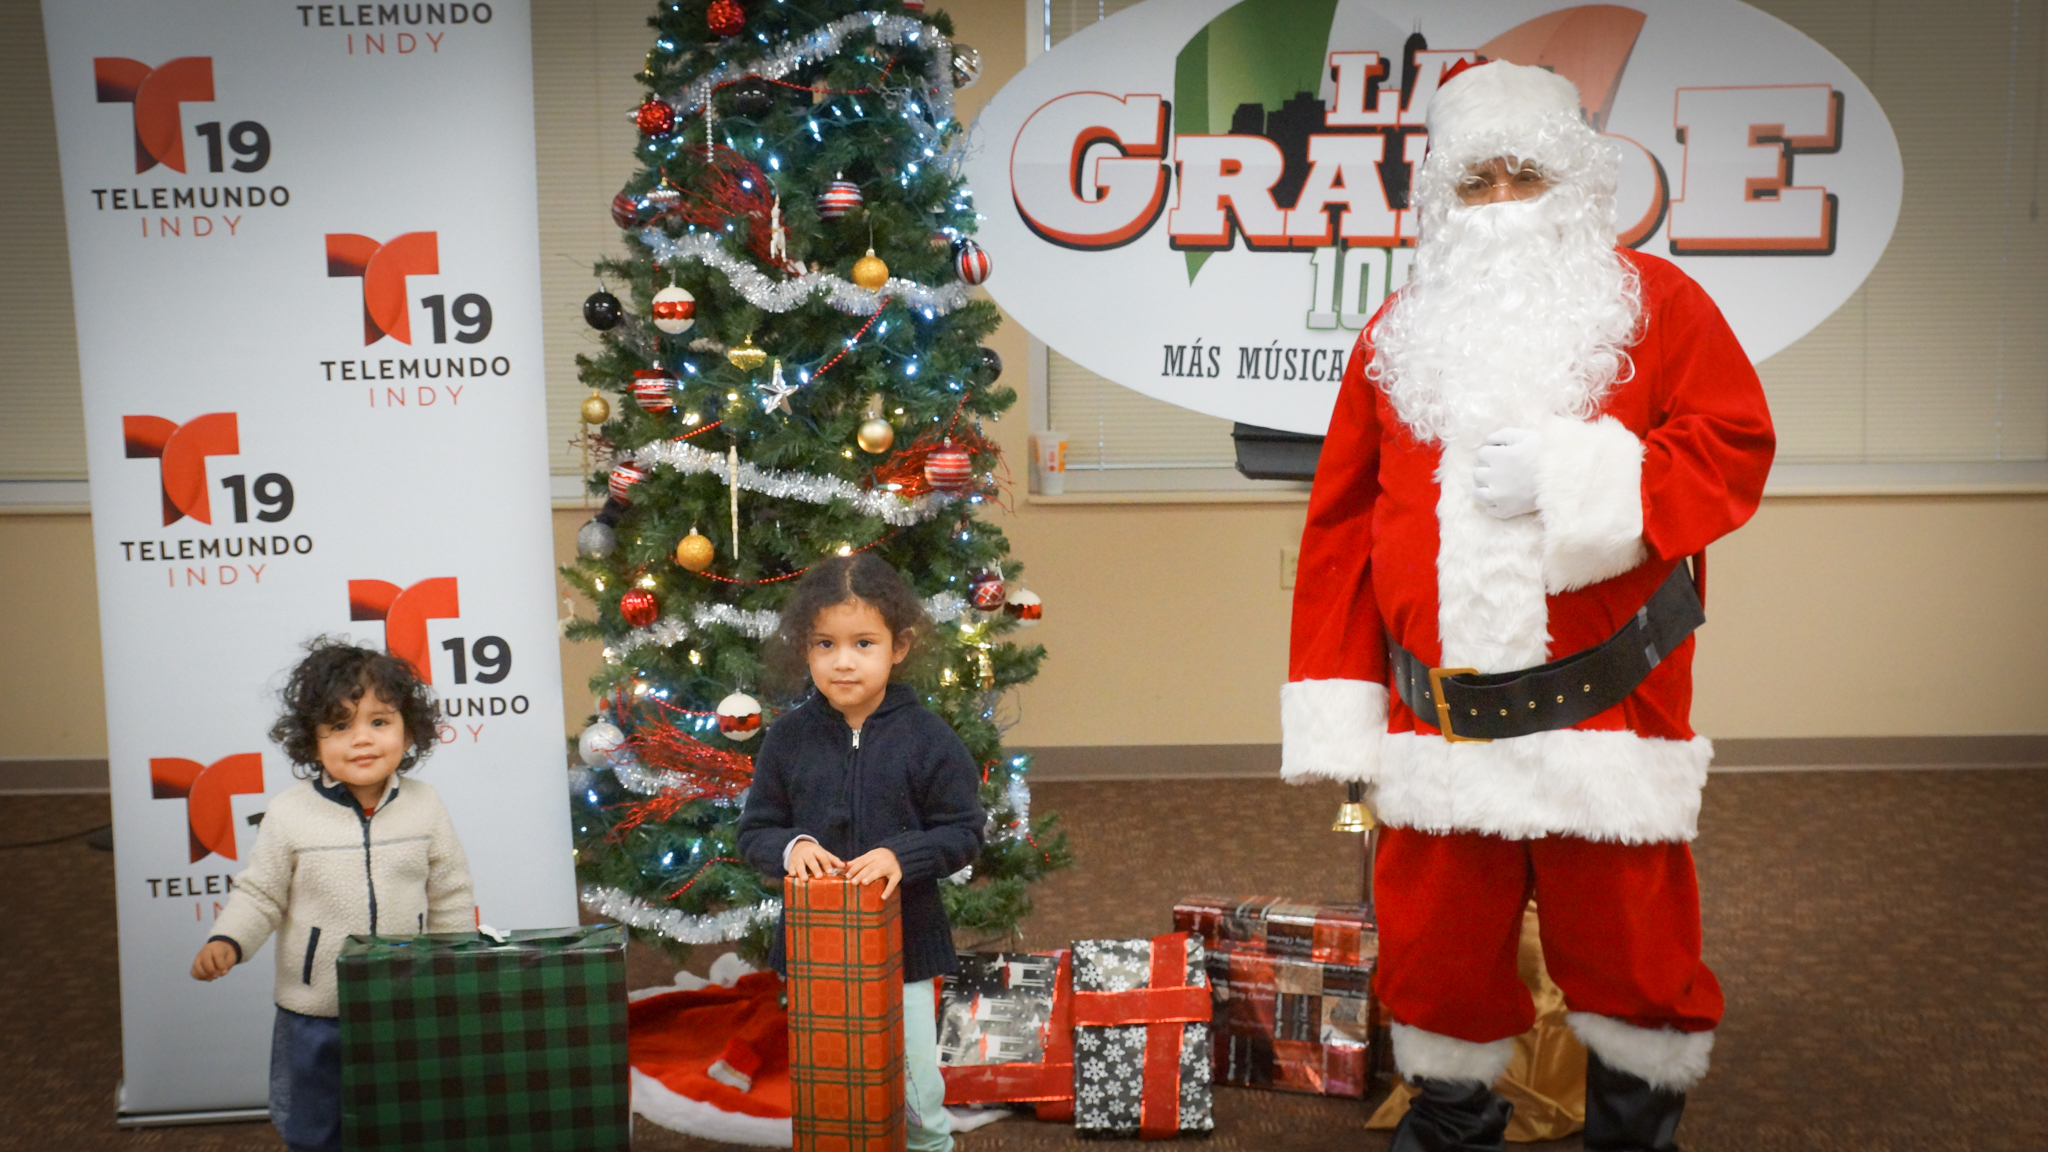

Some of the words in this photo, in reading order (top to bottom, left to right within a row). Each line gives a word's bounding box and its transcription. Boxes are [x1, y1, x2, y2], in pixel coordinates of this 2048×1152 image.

[297, 3, 492, 27] TELEMUNDO
[347, 32, 445, 55] INDY
[195, 120, 271, 173] 19
[1010, 84, 1844, 256] GRAE
[92, 185, 290, 211] TELEMUNDO
[141, 215, 243, 238] INDY
[1306, 246, 1417, 330] 10
[421, 292, 493, 345] 19
[320, 357, 510, 381] TELEMUNDO
[1162, 337, 1221, 378] MÁS
[1237, 340, 1344, 382] MÚSICA
[369, 385, 464, 408] INDY
[221, 472, 295, 523] 19
[121, 534, 313, 562] TELEMUNDO
[168, 564, 267, 588] INDY
[442, 635, 512, 684] 19
[434, 695, 530, 718] UNDO
